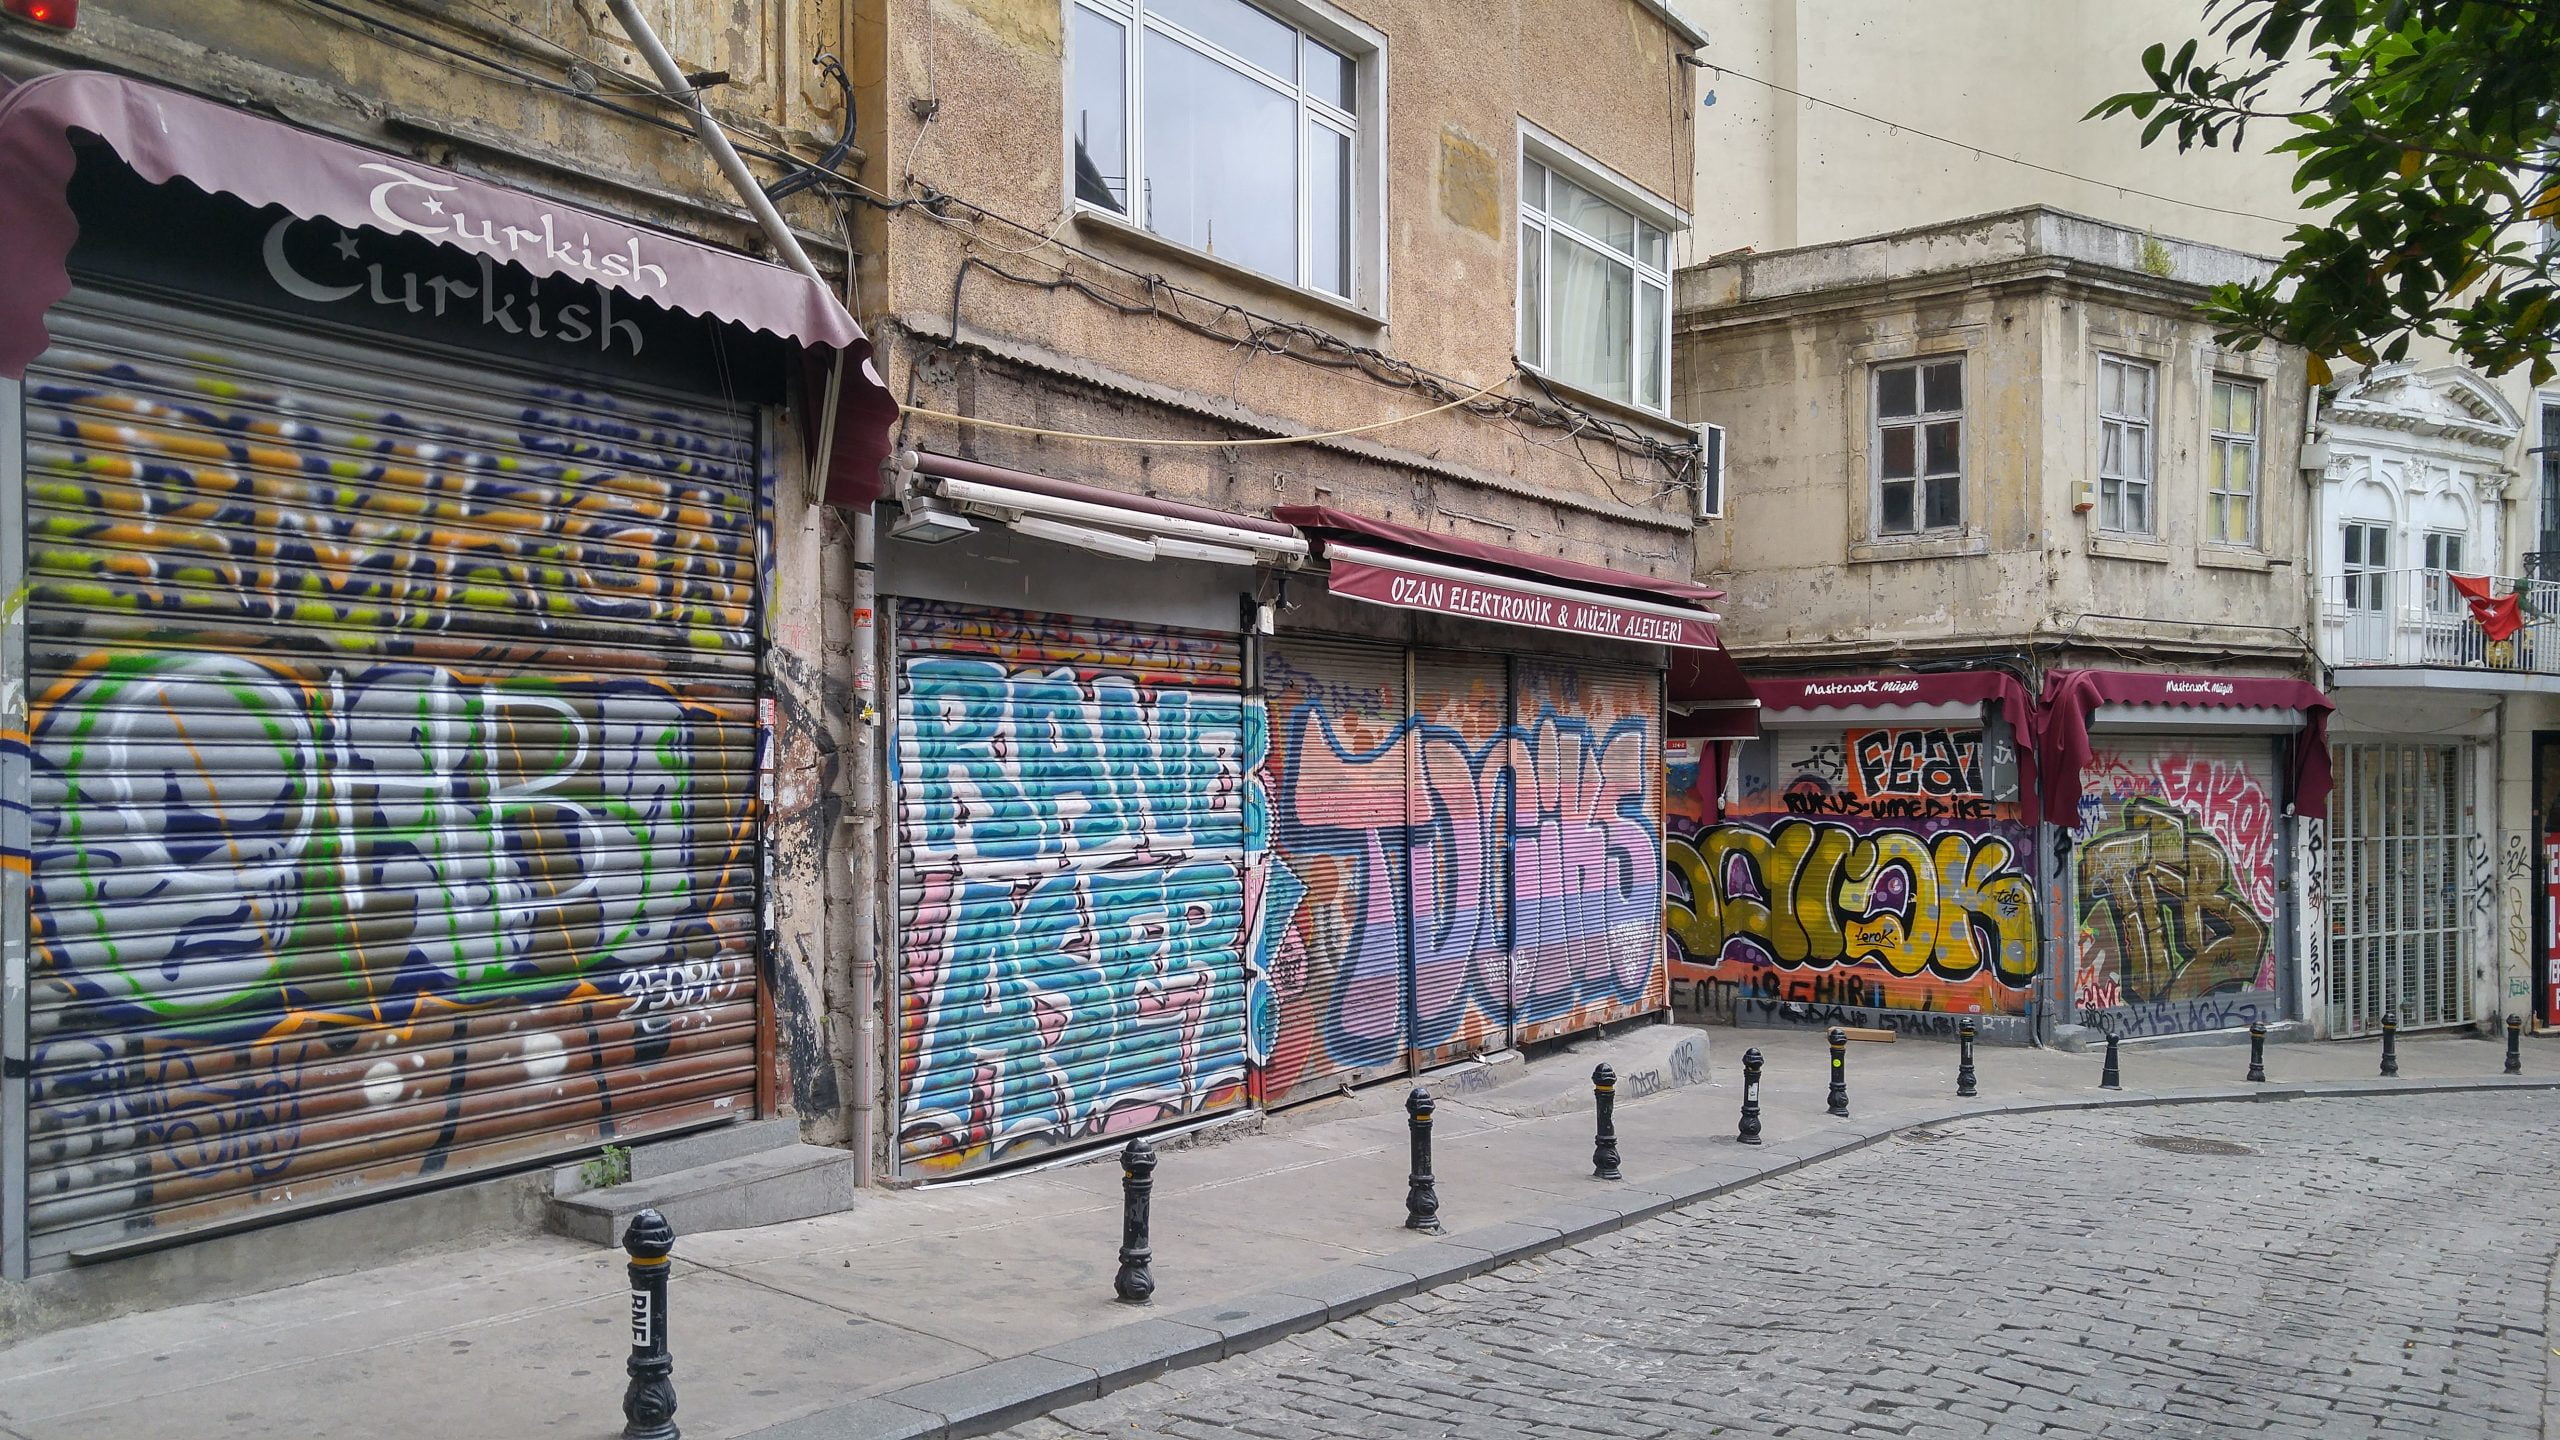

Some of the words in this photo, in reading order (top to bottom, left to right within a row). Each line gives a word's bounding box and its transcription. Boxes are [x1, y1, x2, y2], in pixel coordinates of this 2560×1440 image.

[358, 162, 668, 289] Turkish
[1391, 576, 1443, 607] OZAN
[1450, 586, 1552, 624] ELEKTRONİK
[1558, 607, 1568, 626] &
[1574, 606, 1621, 634] MÜZİK
[1624, 616, 1682, 642] ALETLERİ
[1805, 680, 1878, 696] Masterwork
[2166, 680, 2210, 692] Masterwork
